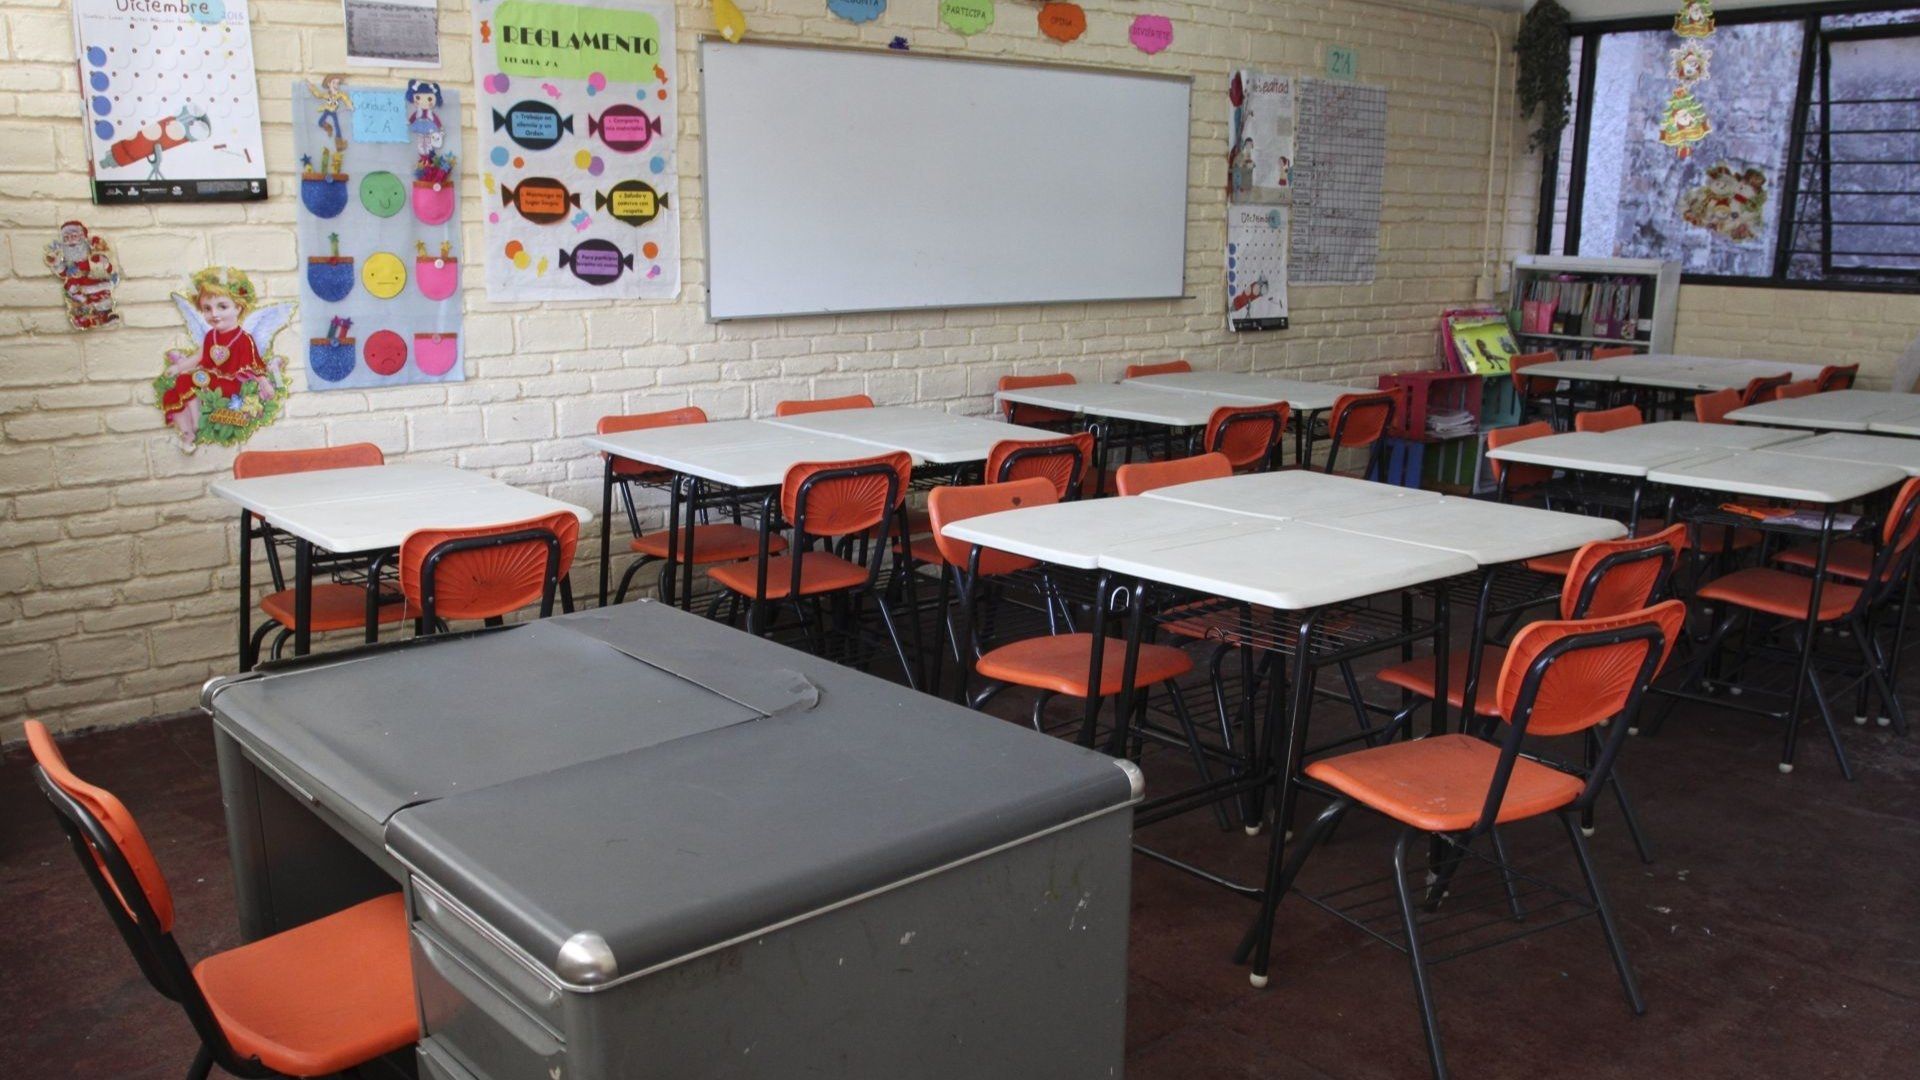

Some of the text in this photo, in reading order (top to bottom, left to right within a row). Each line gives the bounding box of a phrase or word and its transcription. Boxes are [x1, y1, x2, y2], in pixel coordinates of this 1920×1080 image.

[117, 0, 210, 14] Diciembre
[946, 4, 987, 20] PARTICIPA
[503, 25, 659, 56] REGLAMENTO
